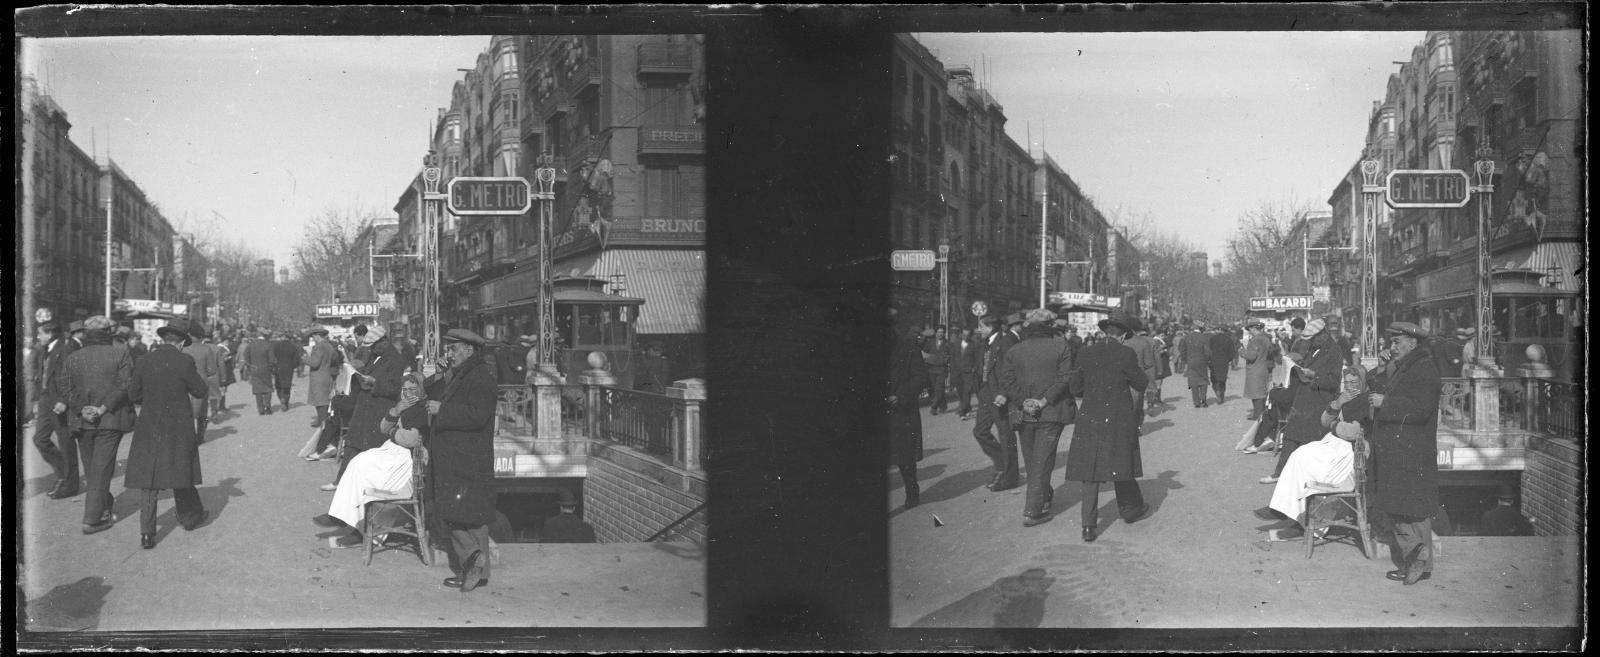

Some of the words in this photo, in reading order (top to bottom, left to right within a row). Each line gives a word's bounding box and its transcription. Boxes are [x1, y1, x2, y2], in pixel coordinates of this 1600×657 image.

[452, 183, 467, 208] G.
[470, 183, 526, 208] METRO
[1391, 176, 1405, 201] G.
[1408, 176, 1466, 201] METRO
[332, 304, 377, 316] BACARDI
[1266, 297, 1311, 309] BACARDI
[494, 456, 514, 472] ADA
[1437, 450, 1452, 465] DA
